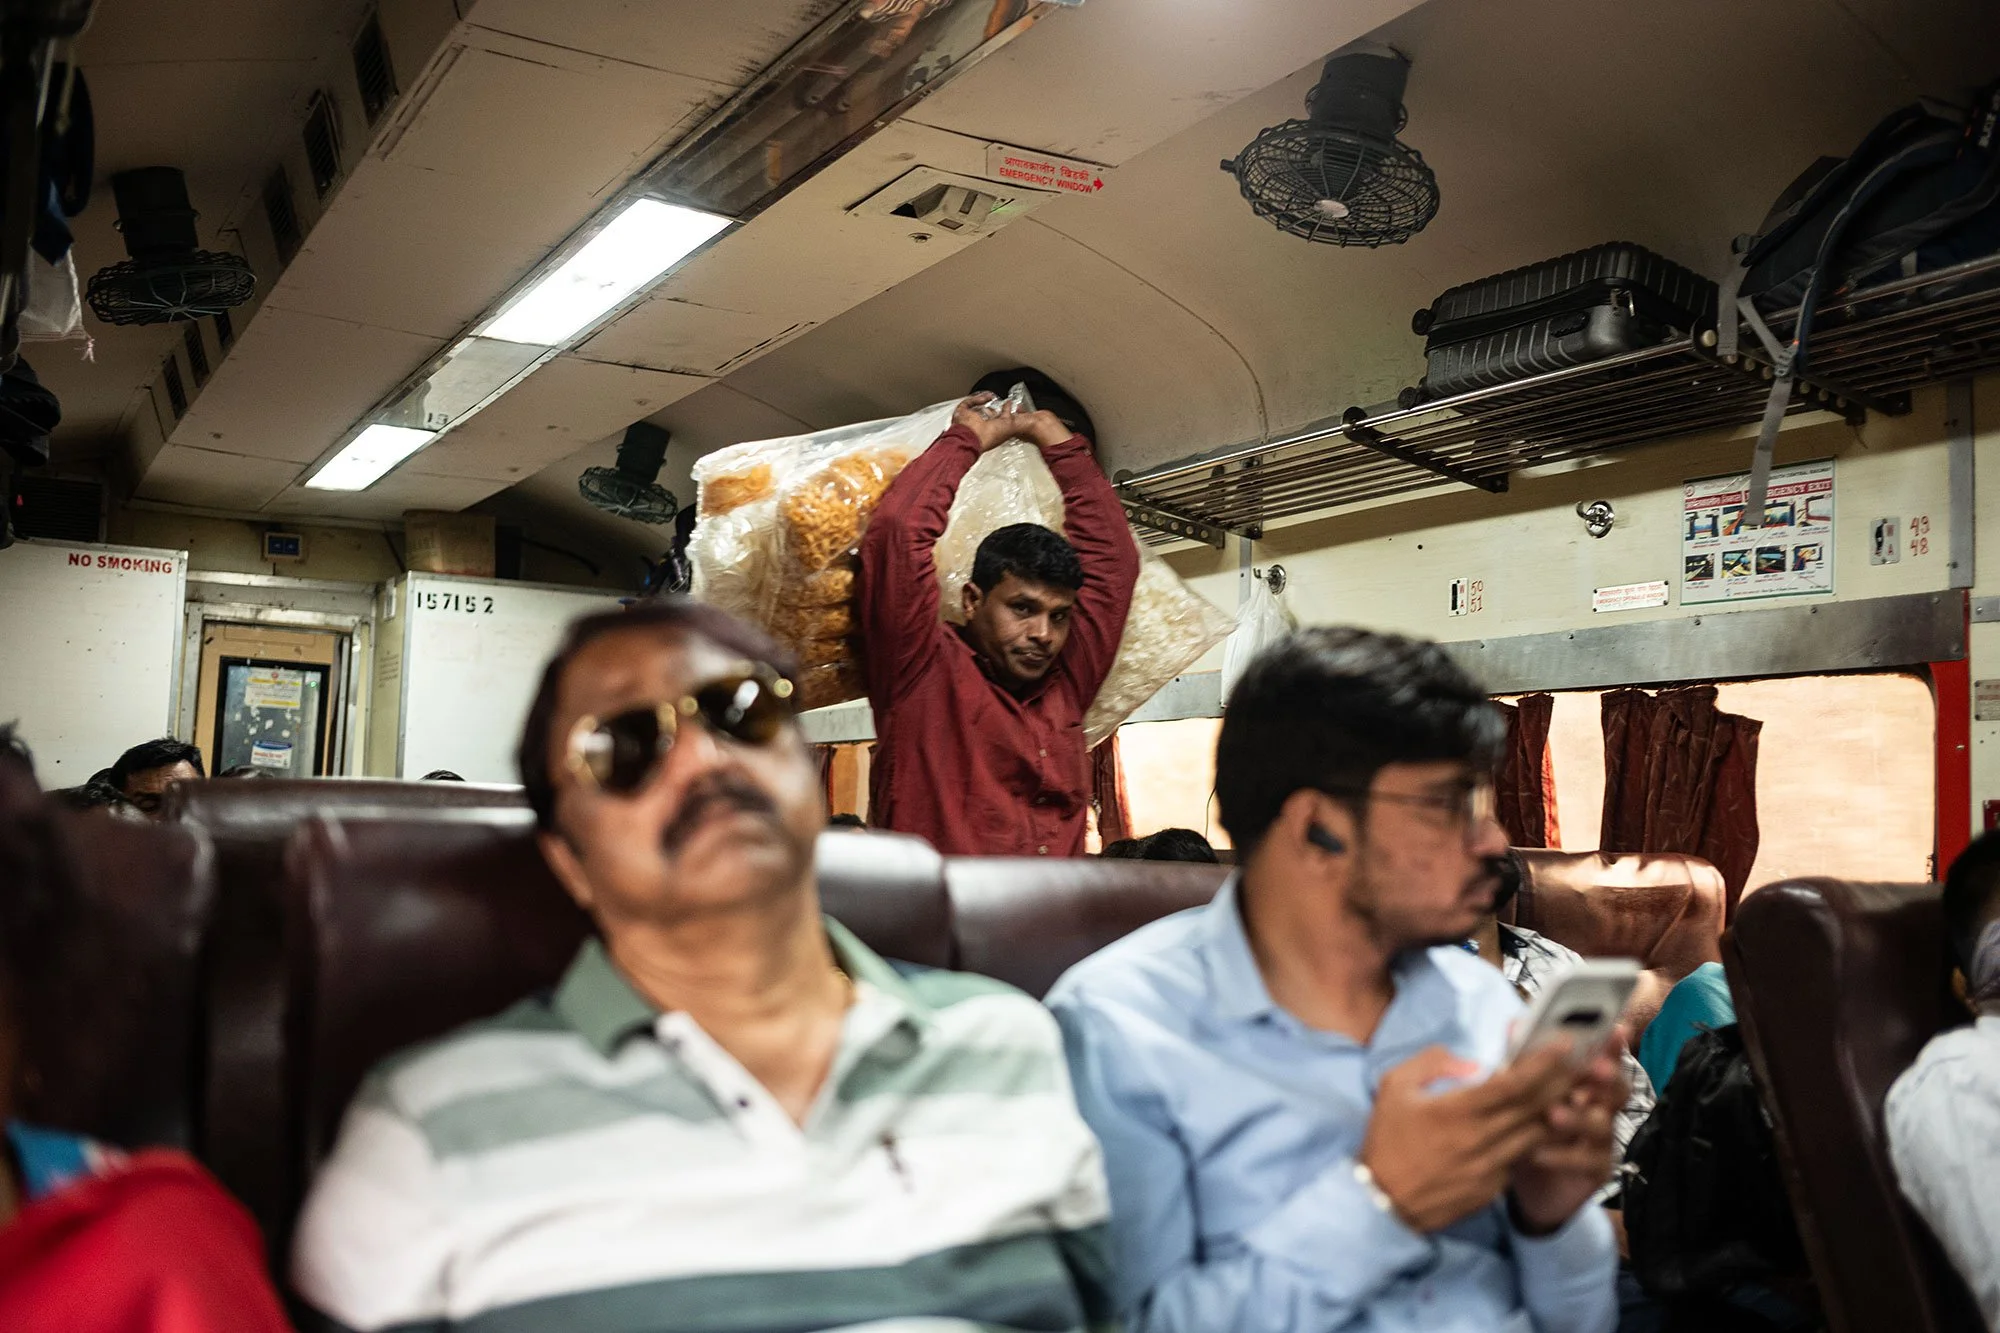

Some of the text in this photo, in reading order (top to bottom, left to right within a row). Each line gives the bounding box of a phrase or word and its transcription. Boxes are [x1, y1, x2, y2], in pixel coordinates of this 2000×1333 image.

[1000, 167, 1093, 193] EMERGENCY WINDOW
[1807, 480, 1832, 490] EXIT
[1910, 515, 1930, 537] 49
[1910, 537, 1929, 556] 48
[68, 553, 172, 574] NO SMOKING
[1471, 580, 1484, 596] 50
[417, 592, 493, 613] 157152
[1470, 595, 1483, 613] 51
